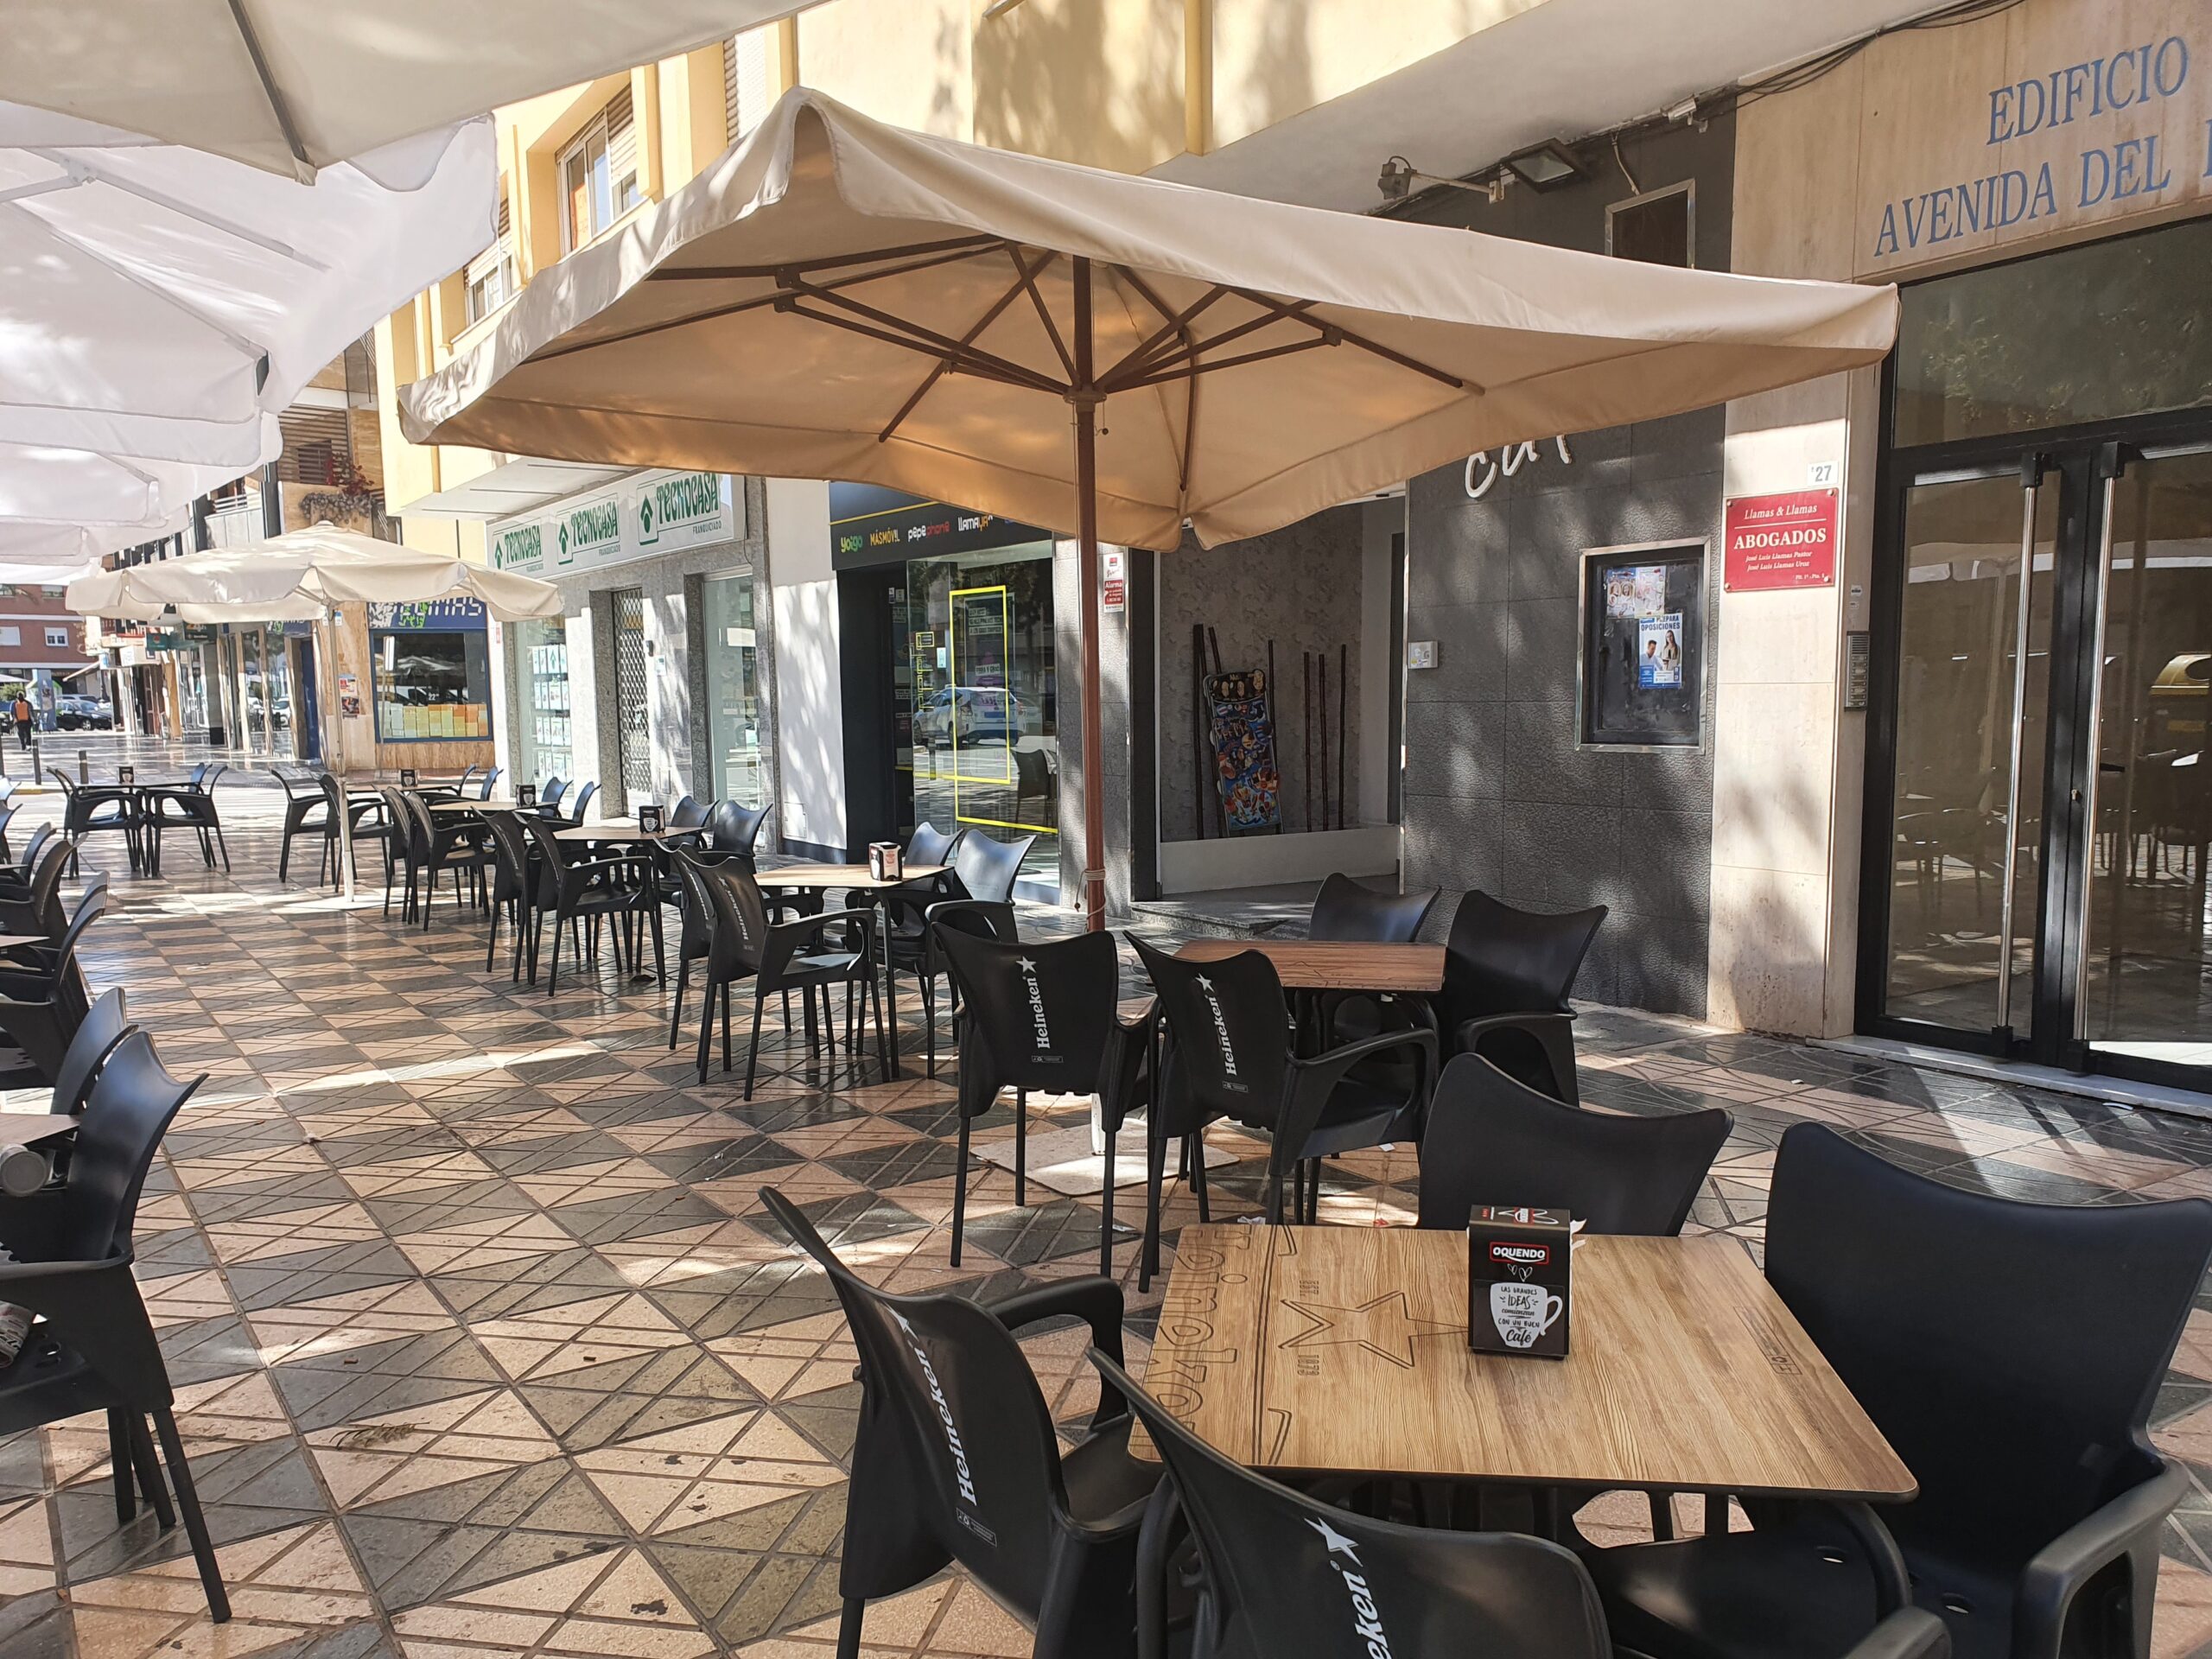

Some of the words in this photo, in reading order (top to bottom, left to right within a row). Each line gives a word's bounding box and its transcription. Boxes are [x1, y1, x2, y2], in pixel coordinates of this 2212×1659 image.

[1986, 35, 2190, 145] EDIFICIO
[1873, 162, 2057, 257] AVENIDA
[2077, 135, 2171, 208] DEL
[657, 471, 719, 524] TECNOCASA
[1744, 508, 1774, 520] Llamas
[1776, 506, 1784, 517] &
[1786, 504, 1818, 517] Llamas
[570, 500, 619, 547] TECNOCASA
[841, 535, 863, 553] yoigo
[907, 521, 950, 542] pepephone
[1733, 528, 1827, 550] ABOGADOS
[505, 524, 542, 564] TECNOCASA
[1641, 622, 1681, 631] OPOSICIONES
[1028, 976, 1051, 1049] Heineken
[1210, 995, 1237, 1076] Heineken
[1492, 1246, 1546, 1260] OQUENDO
[1508, 1294, 1531, 1310] IDEAS
[1513, 1287, 1537, 1295] GRANDES
[1128, 1224, 1252, 1448] Heineke
[1506, 1329, 1532, 1346] Café
[1297, 1354, 1320, 1376] 1873
[913, 1346, 977, 1506] Heineken
